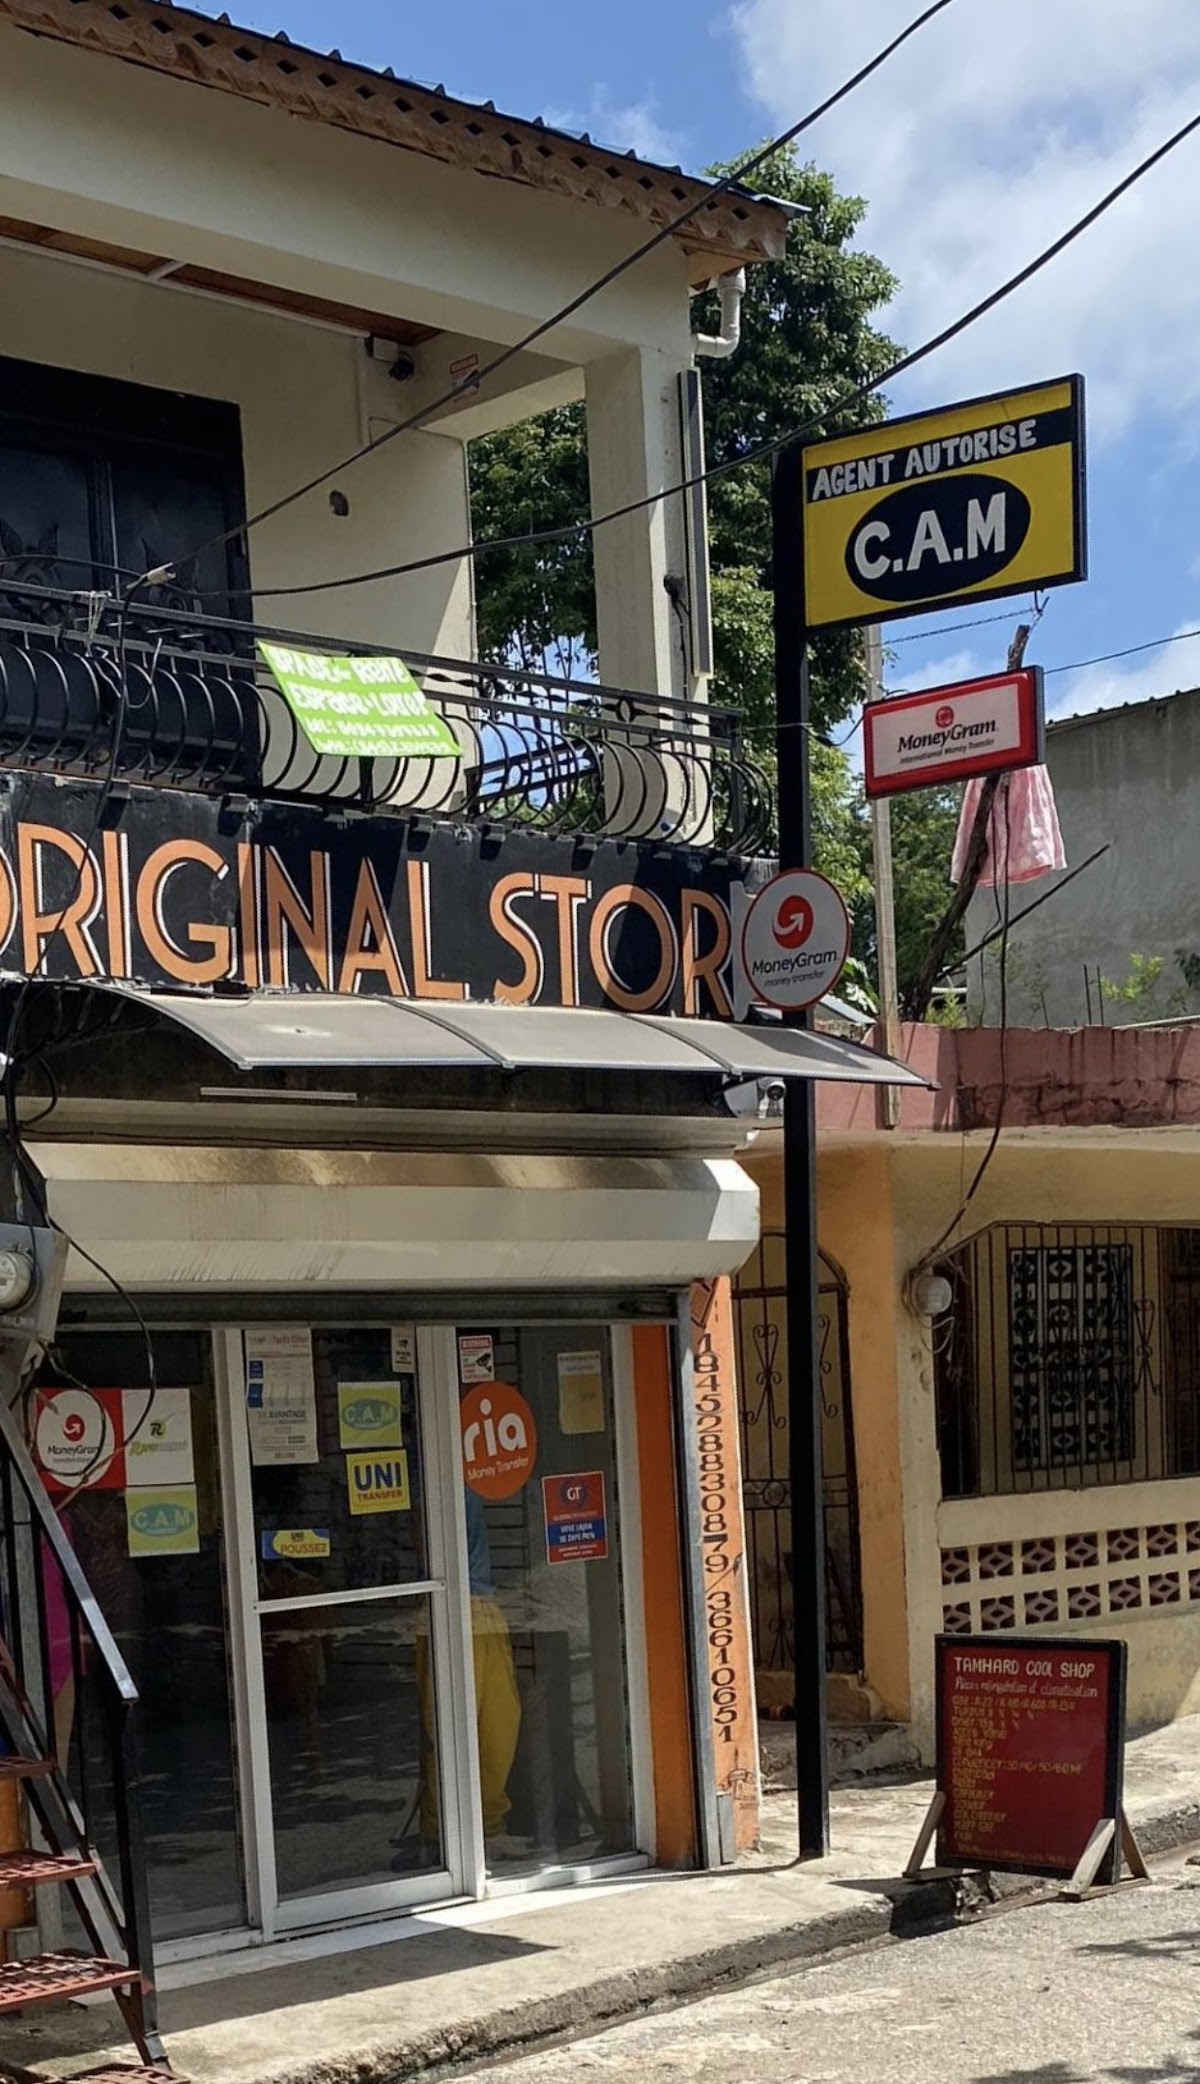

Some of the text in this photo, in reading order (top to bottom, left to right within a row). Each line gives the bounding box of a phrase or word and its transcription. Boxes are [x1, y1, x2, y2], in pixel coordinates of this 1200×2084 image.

[812, 419, 1037, 500] AGENT AUTORISE
[854, 491, 1006, 580] C.A.M
[897, 719, 998, 752] MoneyGram
[945, 746, 967, 755] Money
[0, 822, 472, 1000] RIGINAL
[752, 950, 837, 975] MoneyGram
[463, 1398, 527, 1462] ria
[354, 1461, 402, 1491] UNI
[467, 1457, 529, 1481] Money Transfer
[281, 1543, 327, 1553] POUSSEZ
[954, 1657, 1020, 1675] TAMHARD
[1060, 1662, 1095, 1678] SHOP
